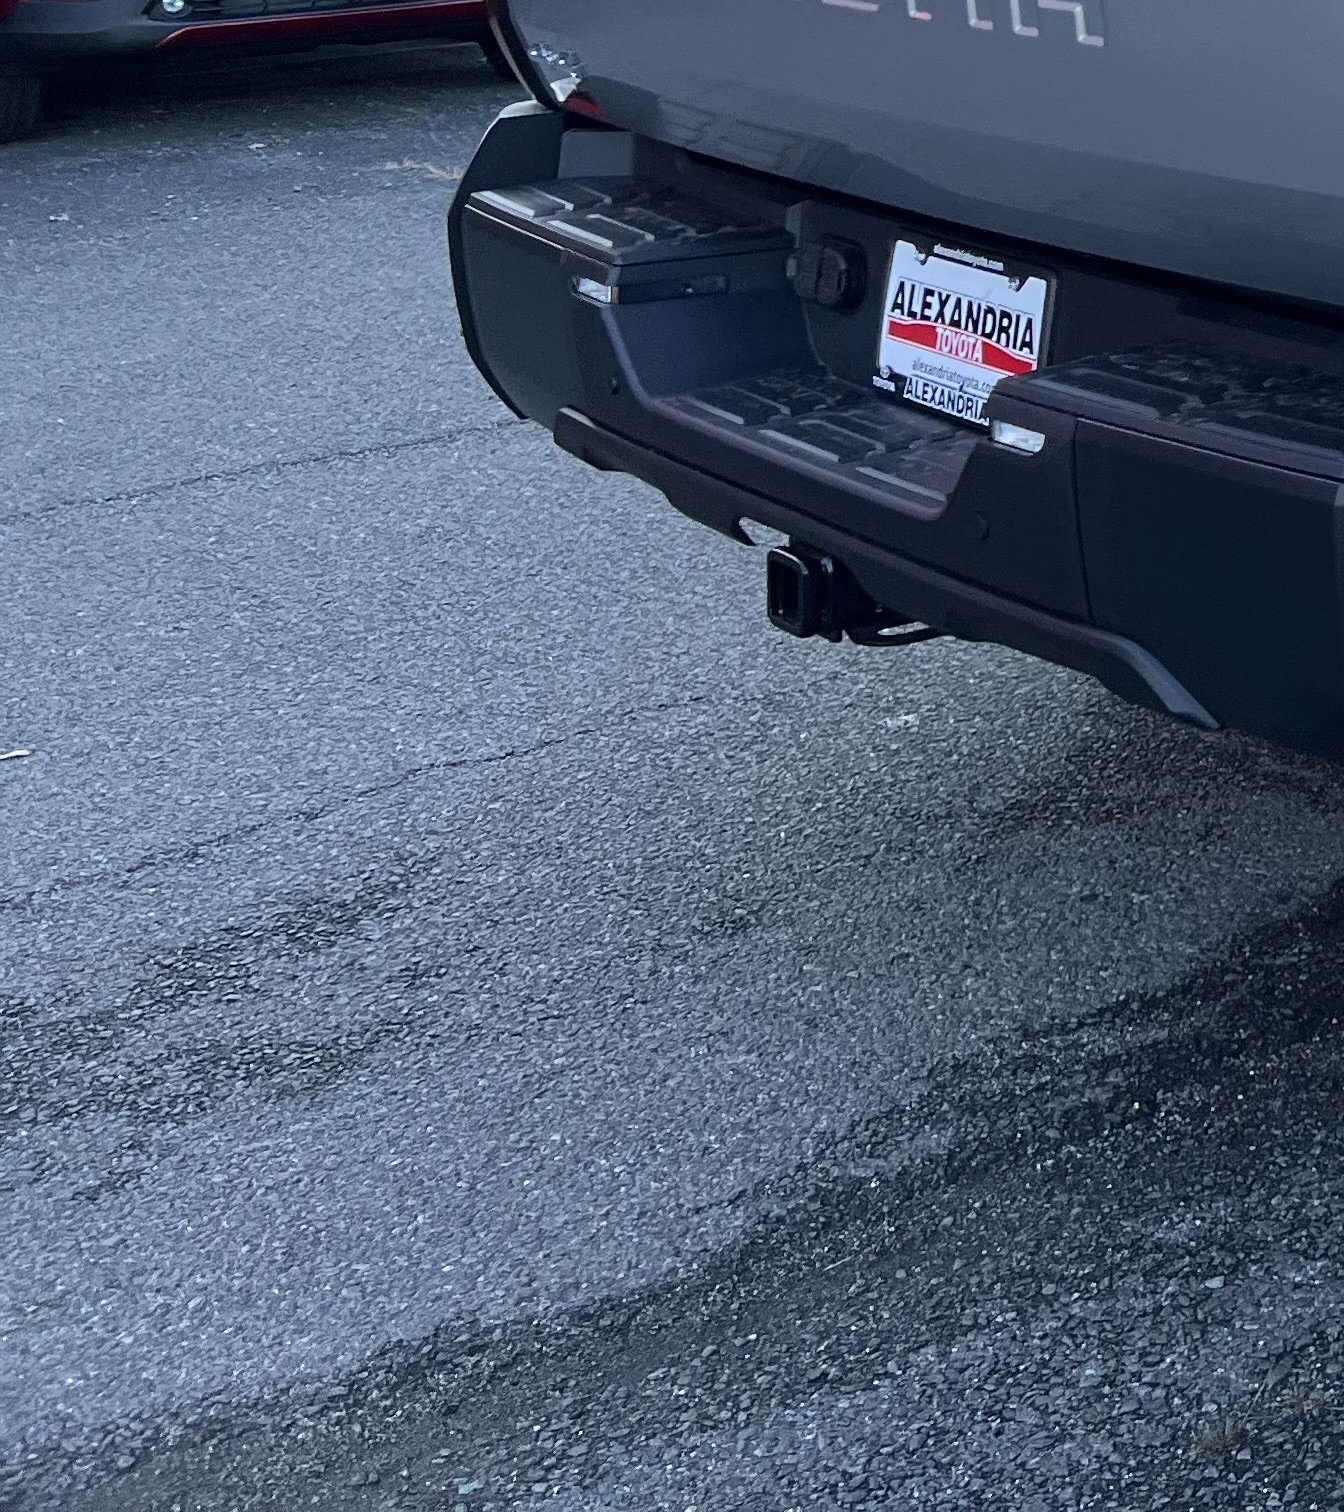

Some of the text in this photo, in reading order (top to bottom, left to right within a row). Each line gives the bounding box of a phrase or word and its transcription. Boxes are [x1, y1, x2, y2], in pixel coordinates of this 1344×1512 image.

[890, 279, 1035, 355] ALEXANDRIA
[935, 326, 984, 364] TOYOTA
[911, 357, 995, 394] alexandriatoyota.co
[904, 376, 989, 423] ALEXANDRI
